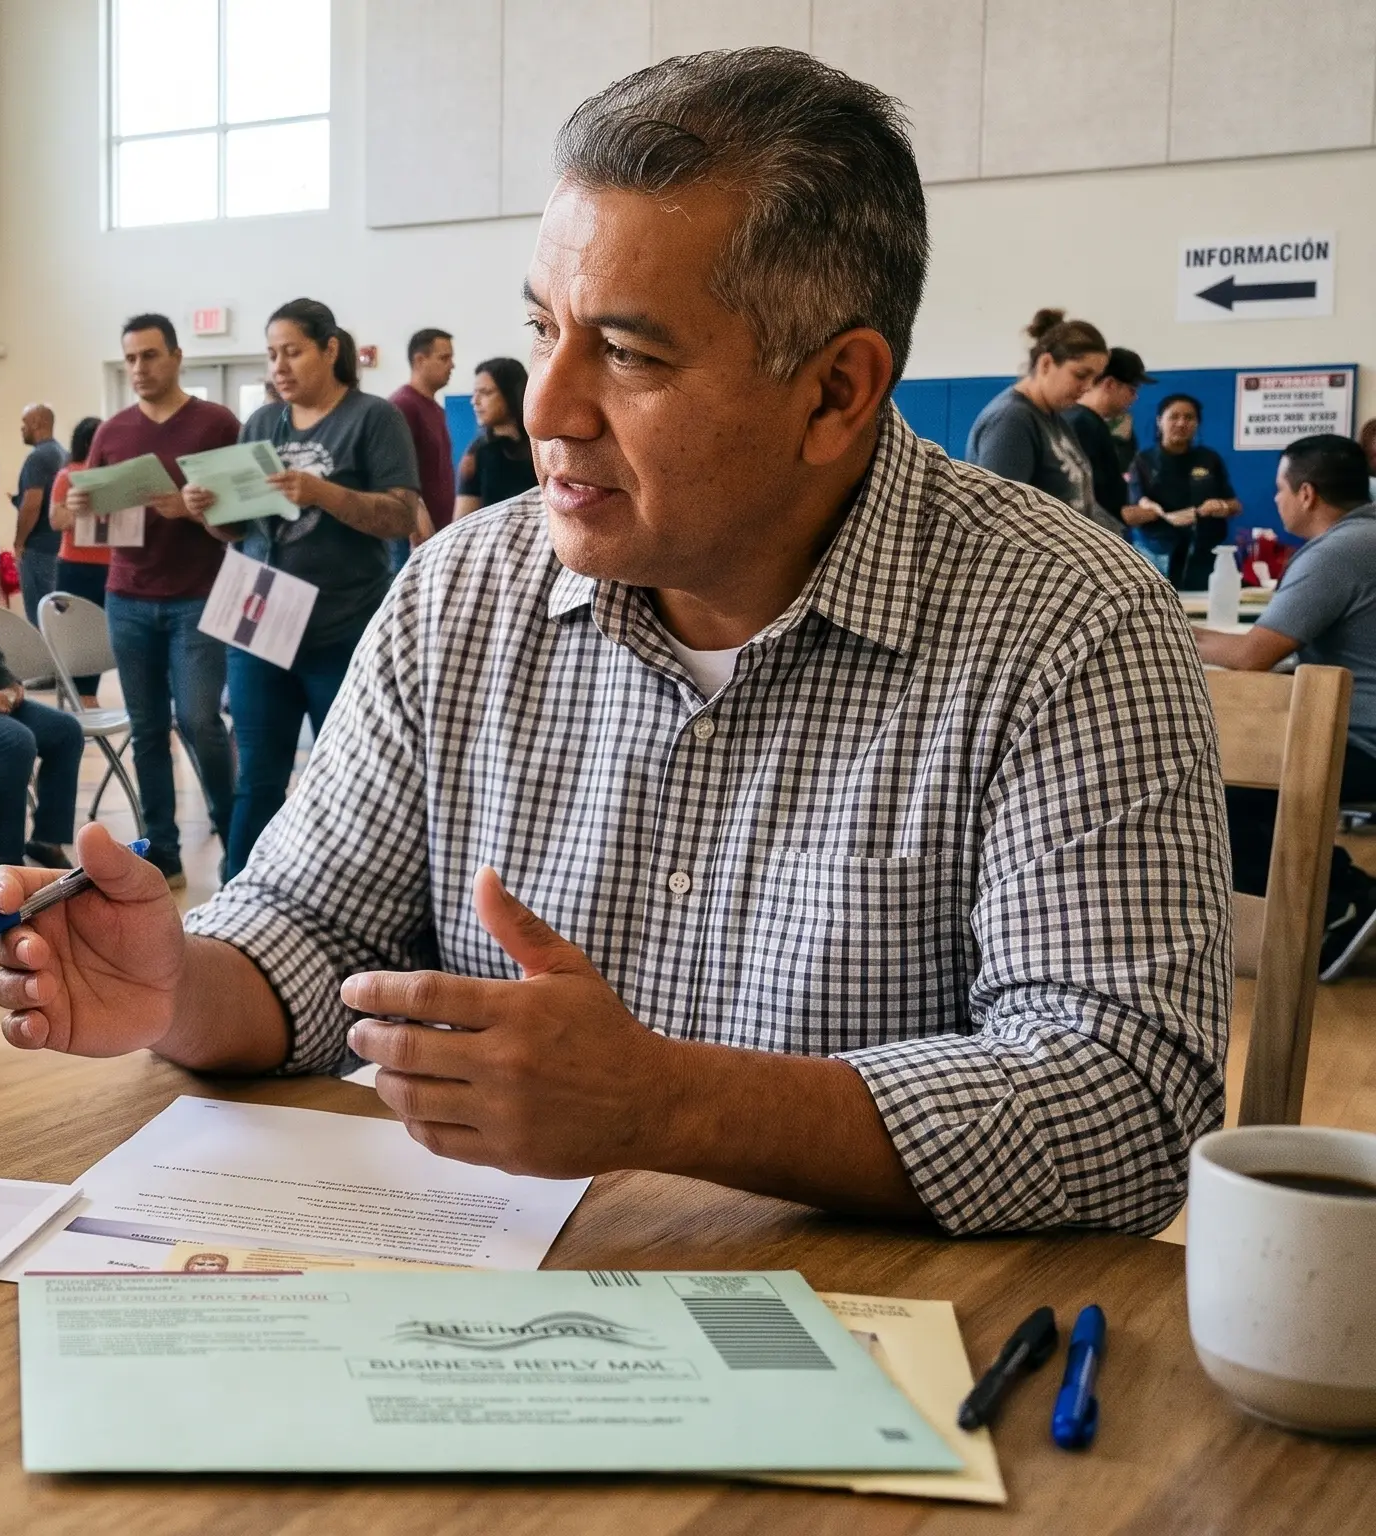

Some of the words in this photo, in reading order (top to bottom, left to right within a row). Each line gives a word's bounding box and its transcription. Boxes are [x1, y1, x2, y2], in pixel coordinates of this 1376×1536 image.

[1186, 238, 1329, 268] INFORMACIÓN
[369, 1359, 505, 1371] BUSINESS
[513, 1359, 598, 1372] REPLY
